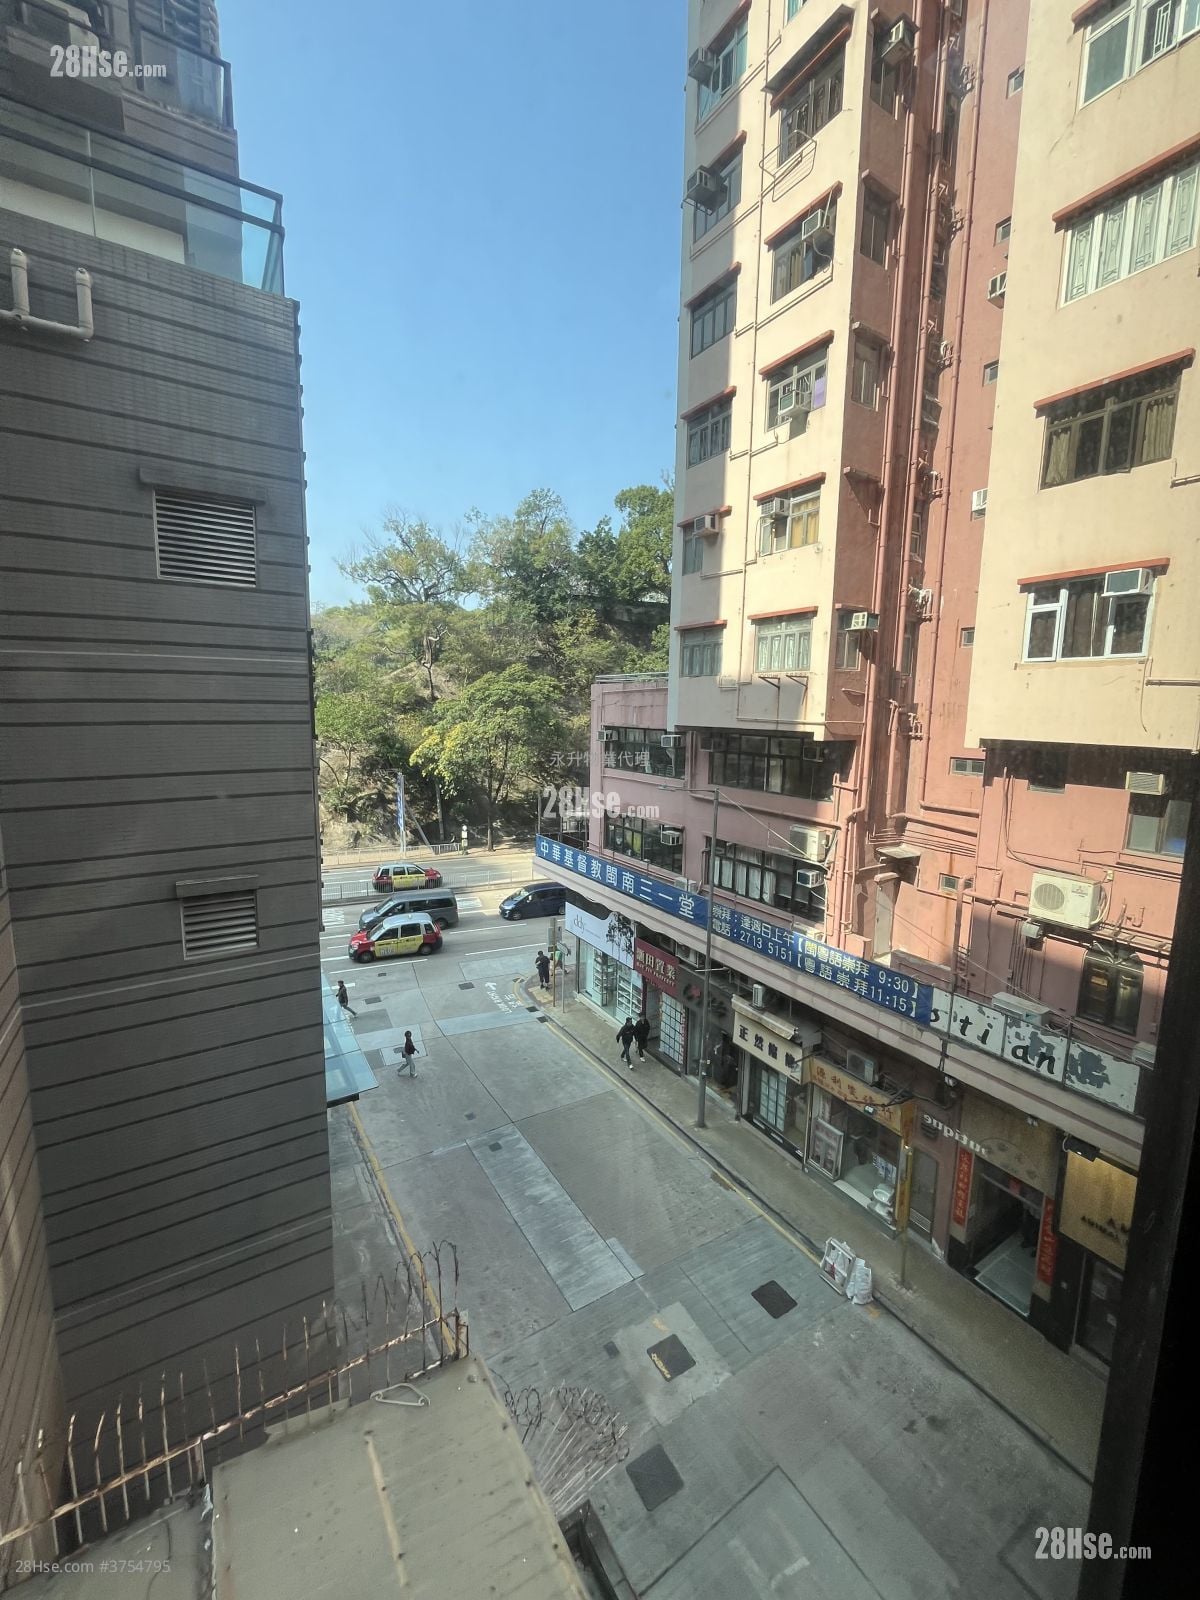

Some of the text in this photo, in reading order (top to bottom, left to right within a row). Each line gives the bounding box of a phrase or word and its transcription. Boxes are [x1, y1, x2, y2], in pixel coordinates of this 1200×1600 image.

[540, 839, 695, 919] 中華基督教閩南三一堂
[767, 942, 792, 963] 5151
